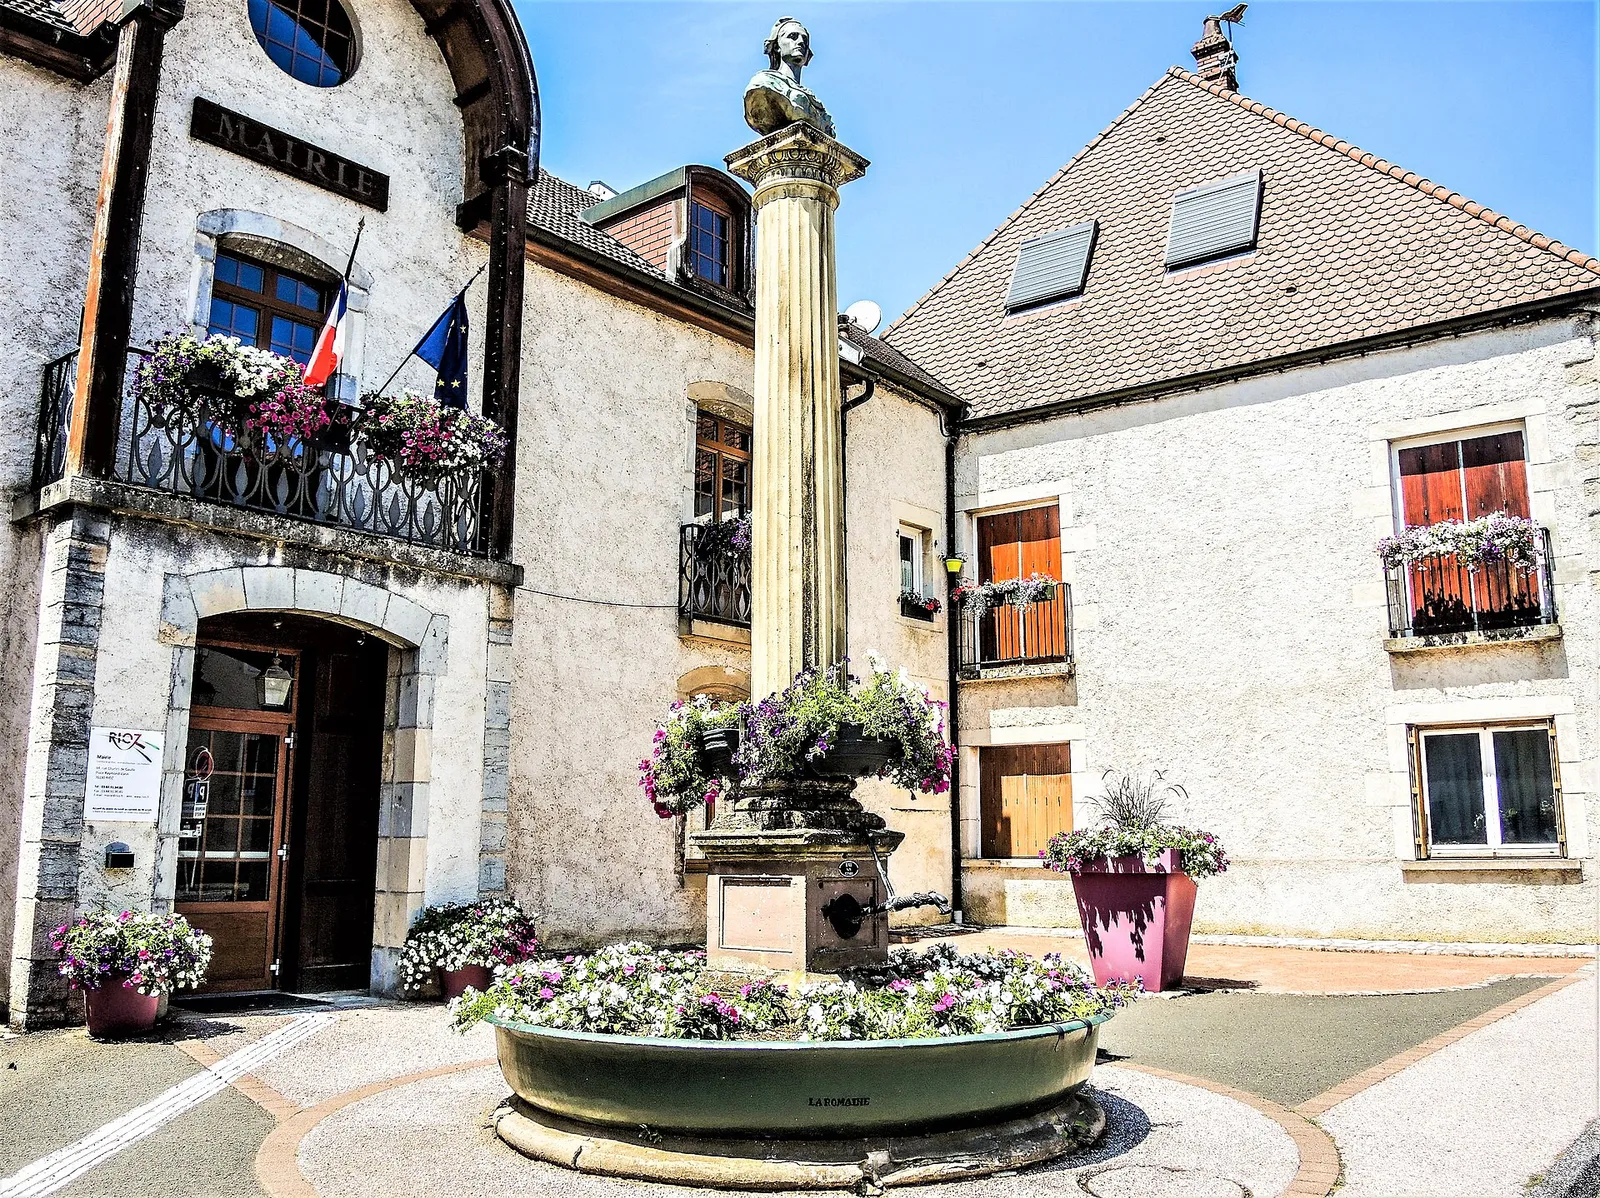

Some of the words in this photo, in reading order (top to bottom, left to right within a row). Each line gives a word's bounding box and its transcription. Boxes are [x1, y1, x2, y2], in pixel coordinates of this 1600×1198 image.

[212, 112, 375, 196] MAIRIE
[808, 1098, 822, 1107] LA
[824, 1097, 870, 1107] ROMAINE
